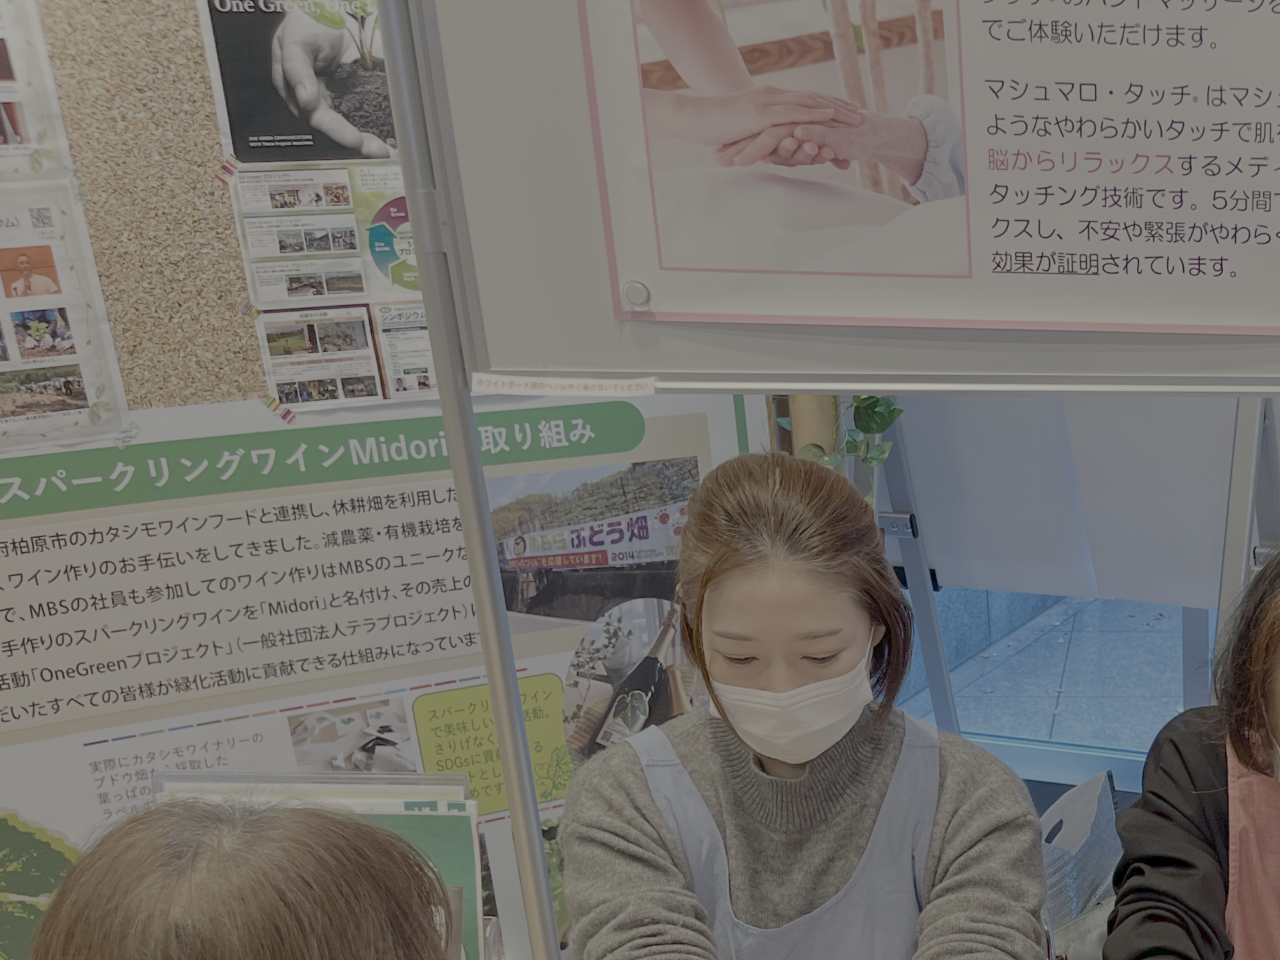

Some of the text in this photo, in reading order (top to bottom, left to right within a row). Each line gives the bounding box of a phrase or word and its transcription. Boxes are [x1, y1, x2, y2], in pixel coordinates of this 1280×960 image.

[214, 0, 255, 12] One
[981, 18, 1218, 50] でご体験いただけます。
[991, 251, 1239, 279] 効果が証明されています。
[570, 515, 650, 549] ぶどう畑
[611, 551, 635, 561] 2014
[0, 632, 480, 720] いたすべての皆様が緑化活動に貢献できる仕組みになっていま
[89, 733, 264, 775] 実際にカタシモワイナリーの
[97, 785, 152, 806] 葉っぱの
